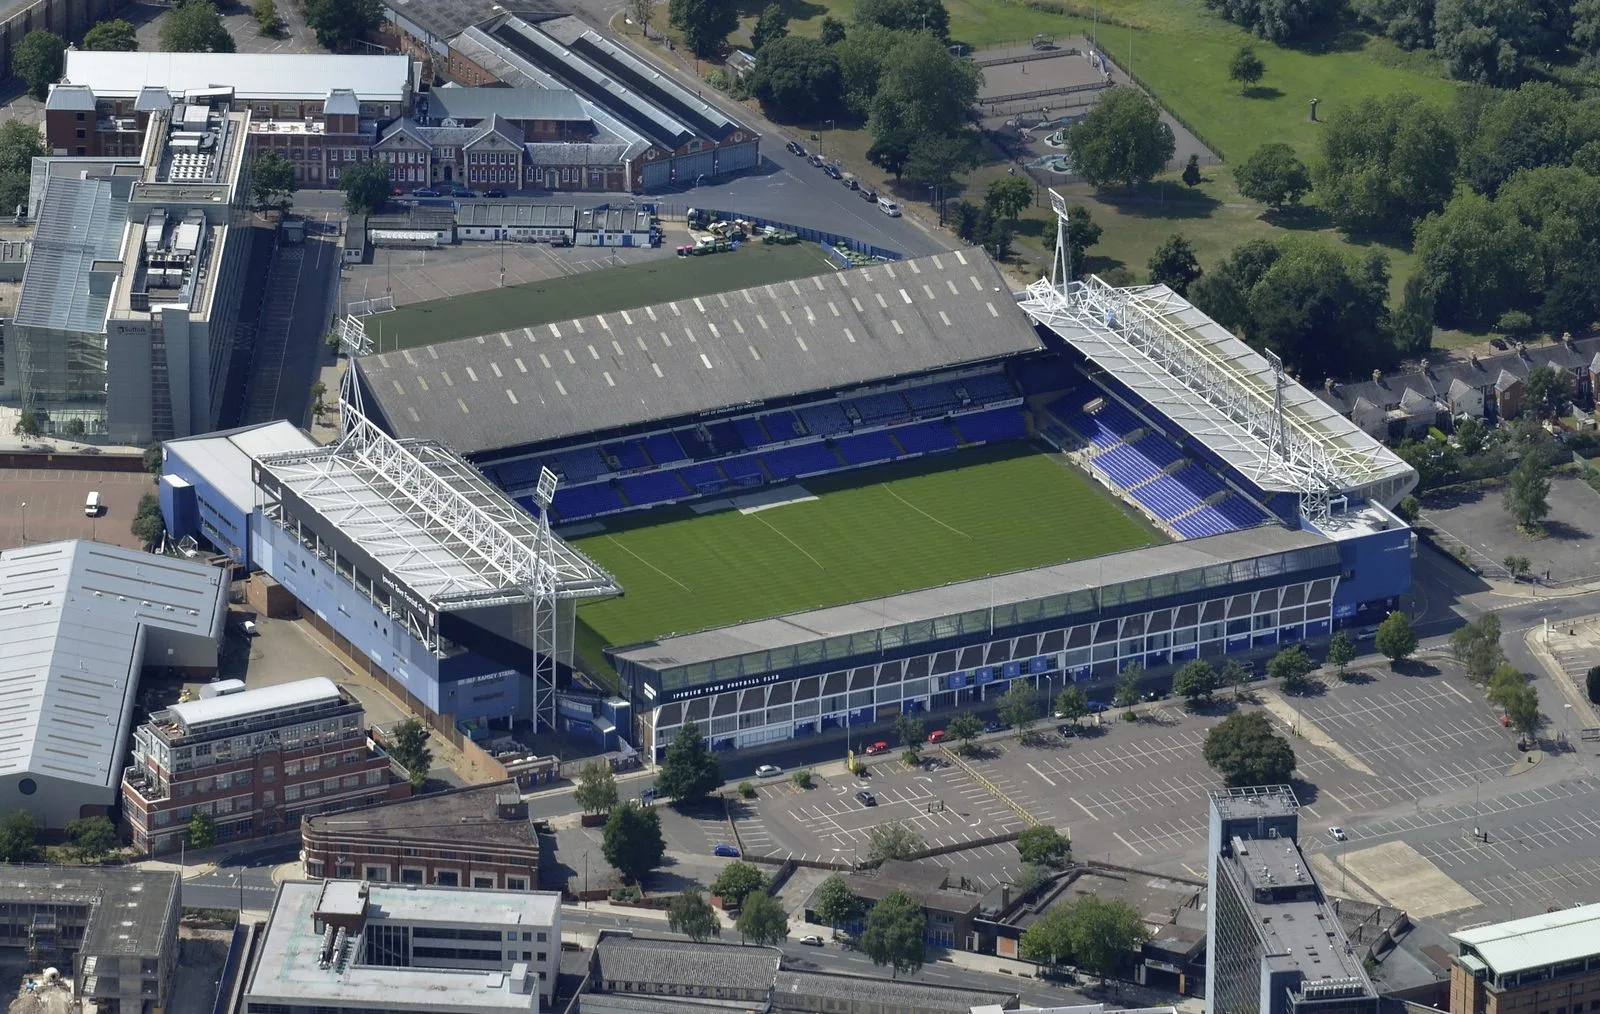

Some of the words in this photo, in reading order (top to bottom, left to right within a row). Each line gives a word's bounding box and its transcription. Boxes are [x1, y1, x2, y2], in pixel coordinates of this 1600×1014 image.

[417, 603, 427, 615] Club
[477, 672, 498, 681] RAMSEY
[673, 688, 702, 699] IPSWICH
[705, 684, 724, 693] TOWN
[727, 678, 760, 689] FOOTBALL
[763, 674, 780, 683] CLUB
